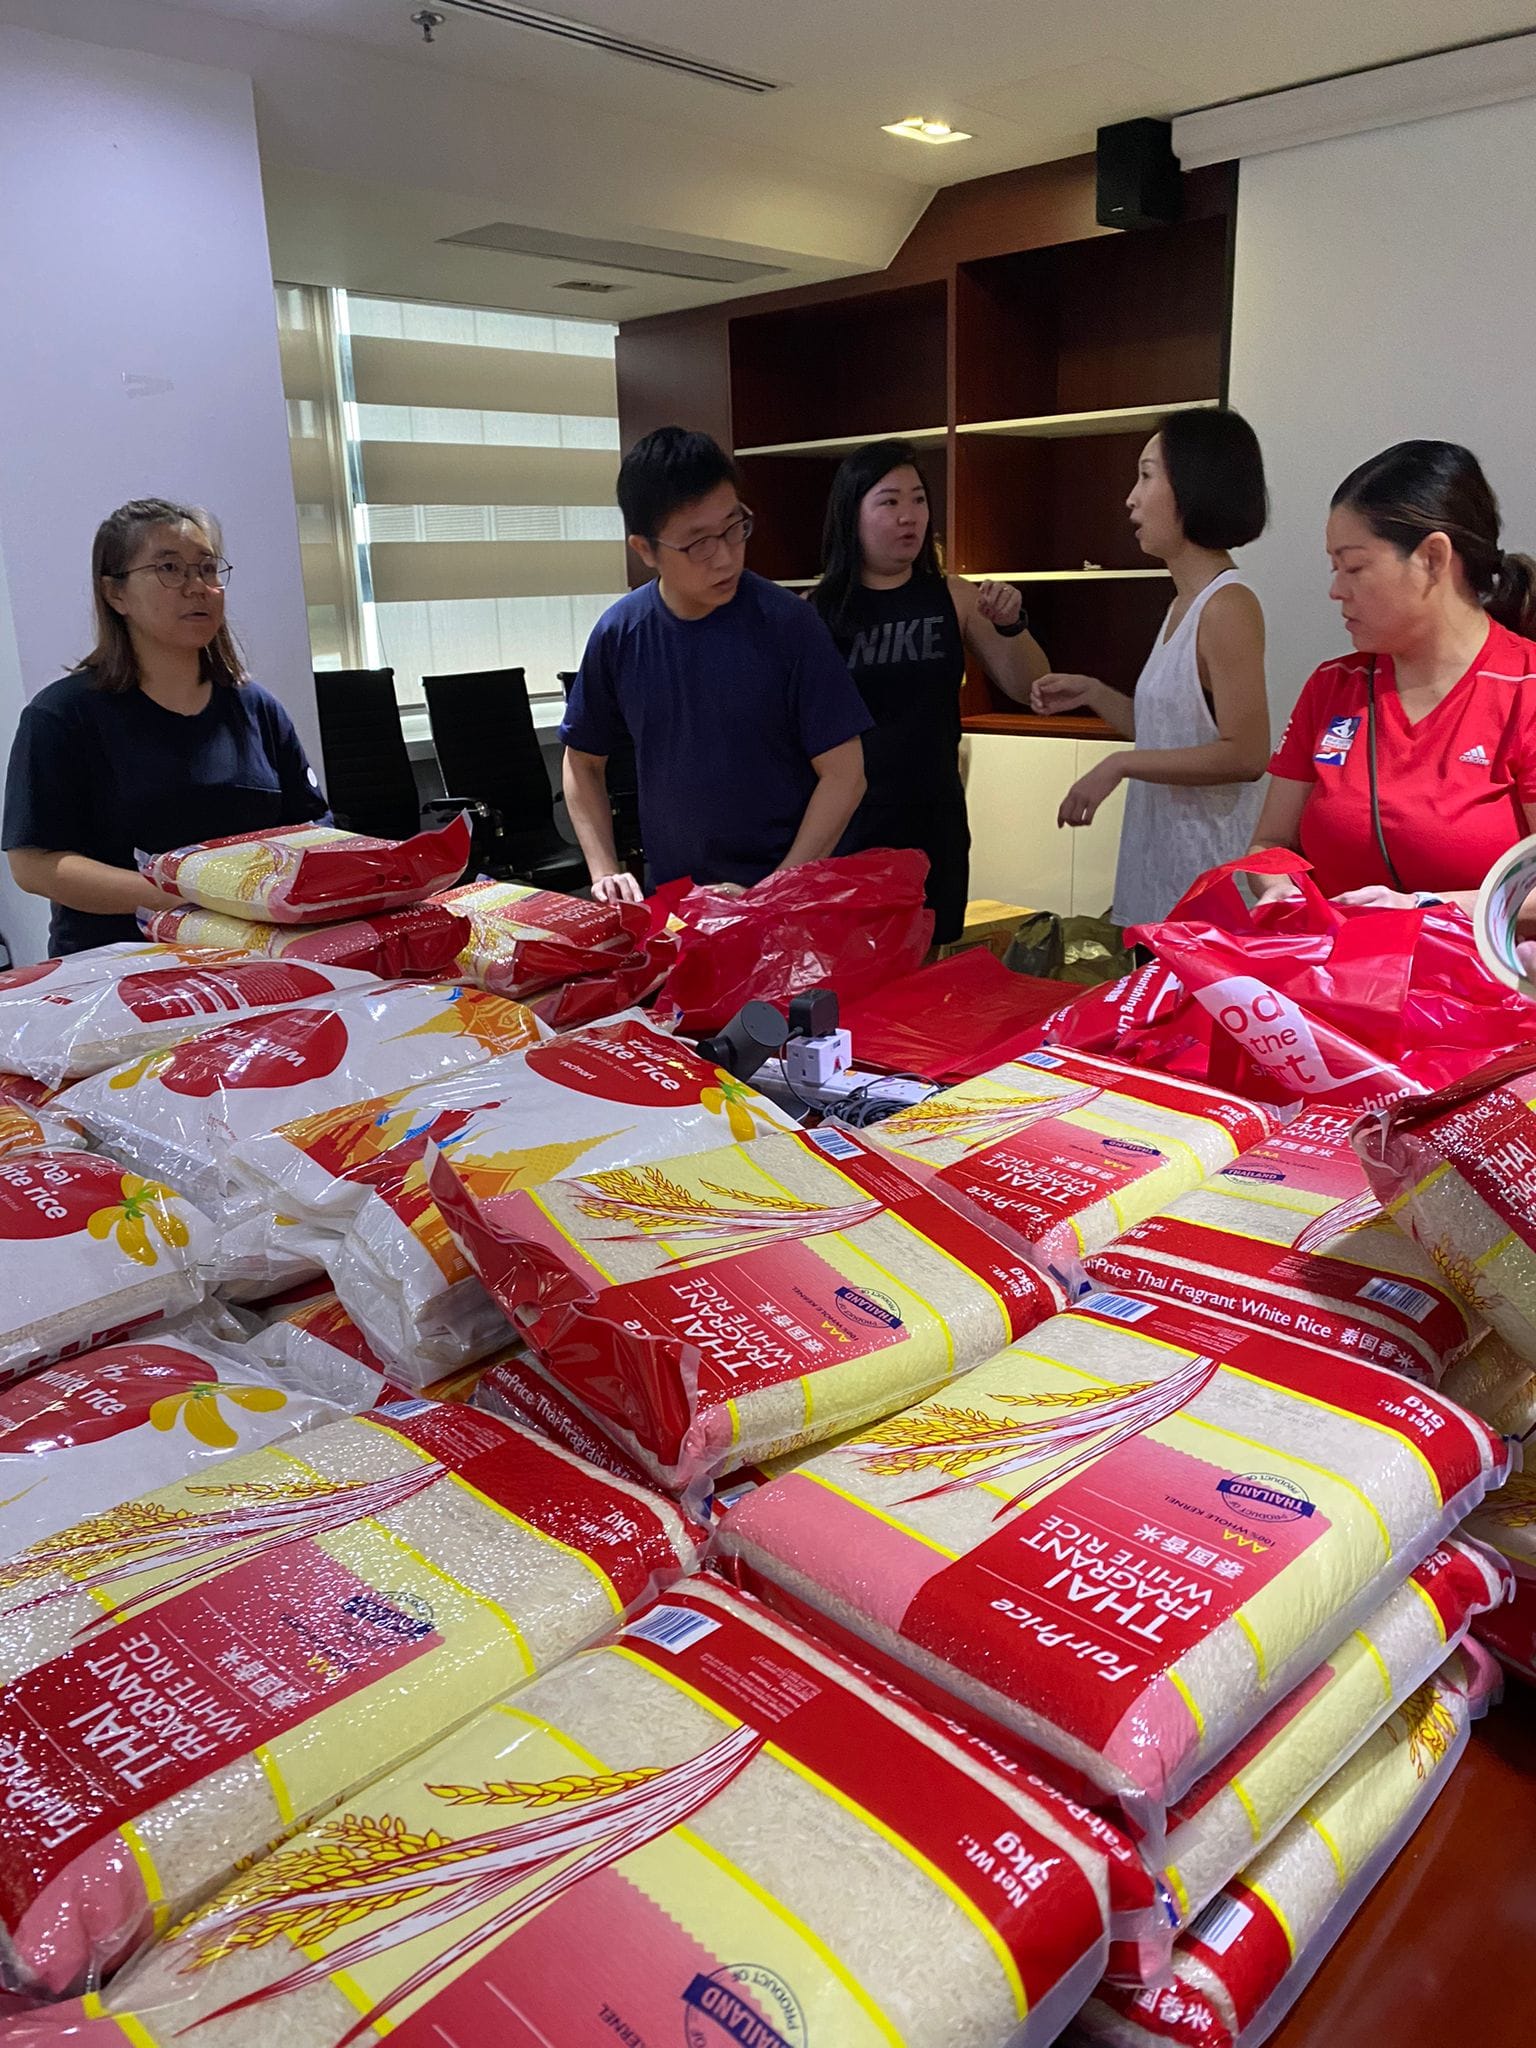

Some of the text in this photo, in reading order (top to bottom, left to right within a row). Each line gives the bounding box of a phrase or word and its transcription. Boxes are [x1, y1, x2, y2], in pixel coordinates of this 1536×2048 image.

[847, 616, 945, 669] NIKE
[1458, 753, 1491, 766] adidas
[627, 1039, 675, 1062] thai
[1249, 1028, 1298, 1054] the
[573, 1035, 682, 1091] white rice
[1281, 1129, 1346, 1147] WHITE
[980, 1157, 1092, 1198] FRAGRANT
[991, 1151, 1097, 1192] WHITE RICE
[996, 1172, 1070, 1204] THAI
[23, 1186, 68, 1219] rice
[965, 1184, 1053, 1223] FairPrice
[669, 1283, 780, 1370] FRAGRANT
[690, 1276, 795, 1365] WHITE RICE
[844, 1291, 894, 1322] THAILAND
[1136, 1268, 1169, 1290] Thai
[1170, 1278, 1237, 1310] Fragrant
[1241, 1297, 1292, 1327] White
[1294, 1314, 1333, 1338] Rice
[1340, 1327, 1417, 1370] 泰国香米
[671, 1313, 749, 1378] THAI
[756, 1301, 827, 1354] 泰国香米
[821, 1320, 852, 1343] AAA
[79, 1388, 127, 1416] rice
[1403, 1395, 1446, 1430] 5kg
[1407, 1413, 1435, 1438] Net
[1164, 1495, 1206, 1515] KERNEL
[1229, 1483, 1303, 1511] THAILAND
[1259, 1474, 1301, 1495] PRODUCT
[602, 1510, 639, 1541] 5kg
[1204, 1511, 1249, 1535] WHOLE
[1222, 1528, 1270, 1554] AAA
[1038, 1514, 1214, 1606] WHITE RICE
[1134, 1523, 1245, 1580] 泰国香米
[1018, 1530, 1202, 1621] FRAGRANT
[1043, 1568, 1169, 1643] THAI
[990, 1598, 1139, 1682] FairPrice
[84, 1652, 220, 1761] FRAGRANT
[119, 1631, 250, 1742] WHITE RICE
[67, 1701, 176, 1790] THAI
[966, 1736, 1133, 1863] FairPrice Thai
[992, 1867, 1030, 1909] Net
[752, 1972, 799, 2031] PRODUCT
